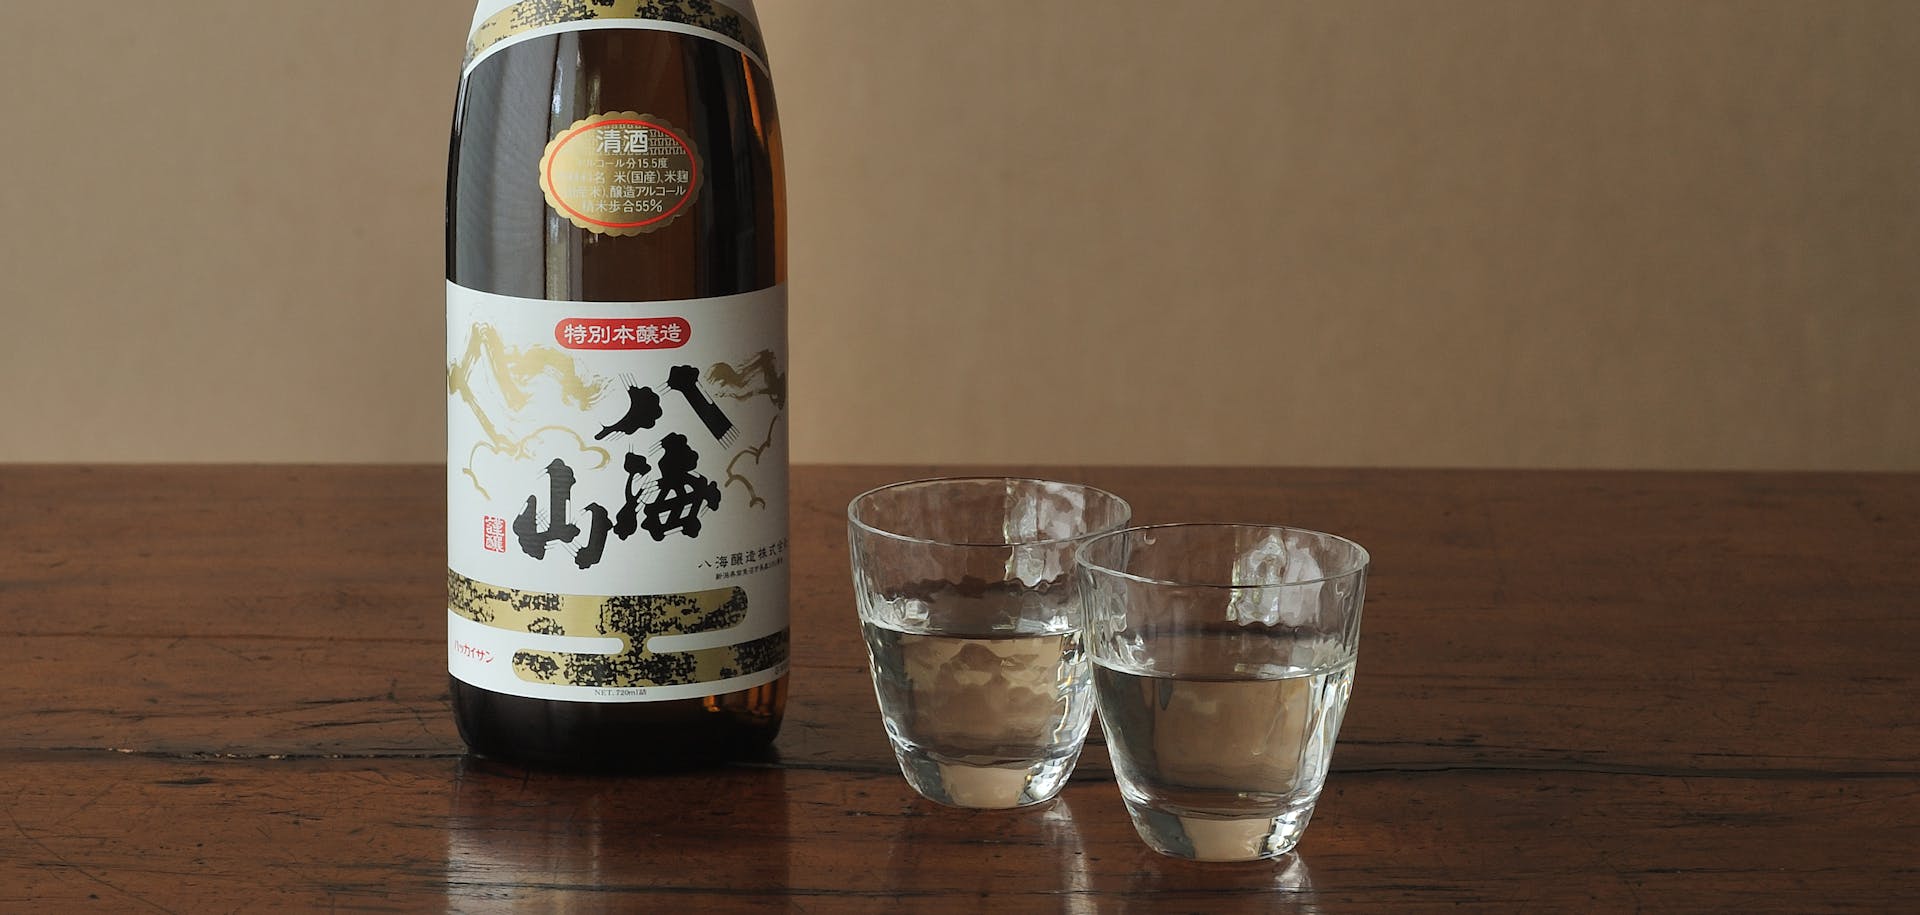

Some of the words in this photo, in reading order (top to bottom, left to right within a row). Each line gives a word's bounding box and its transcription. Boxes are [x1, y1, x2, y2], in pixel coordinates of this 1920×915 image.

[596, 129, 648, 154] 清酒
[578, 158, 668, 169] ルコール分15.5度
[564, 323, 682, 345] 特別本醸造
[697, 537, 788, 569] 八海醸造株式会
[454, 639, 495, 664] ハッカイサン
